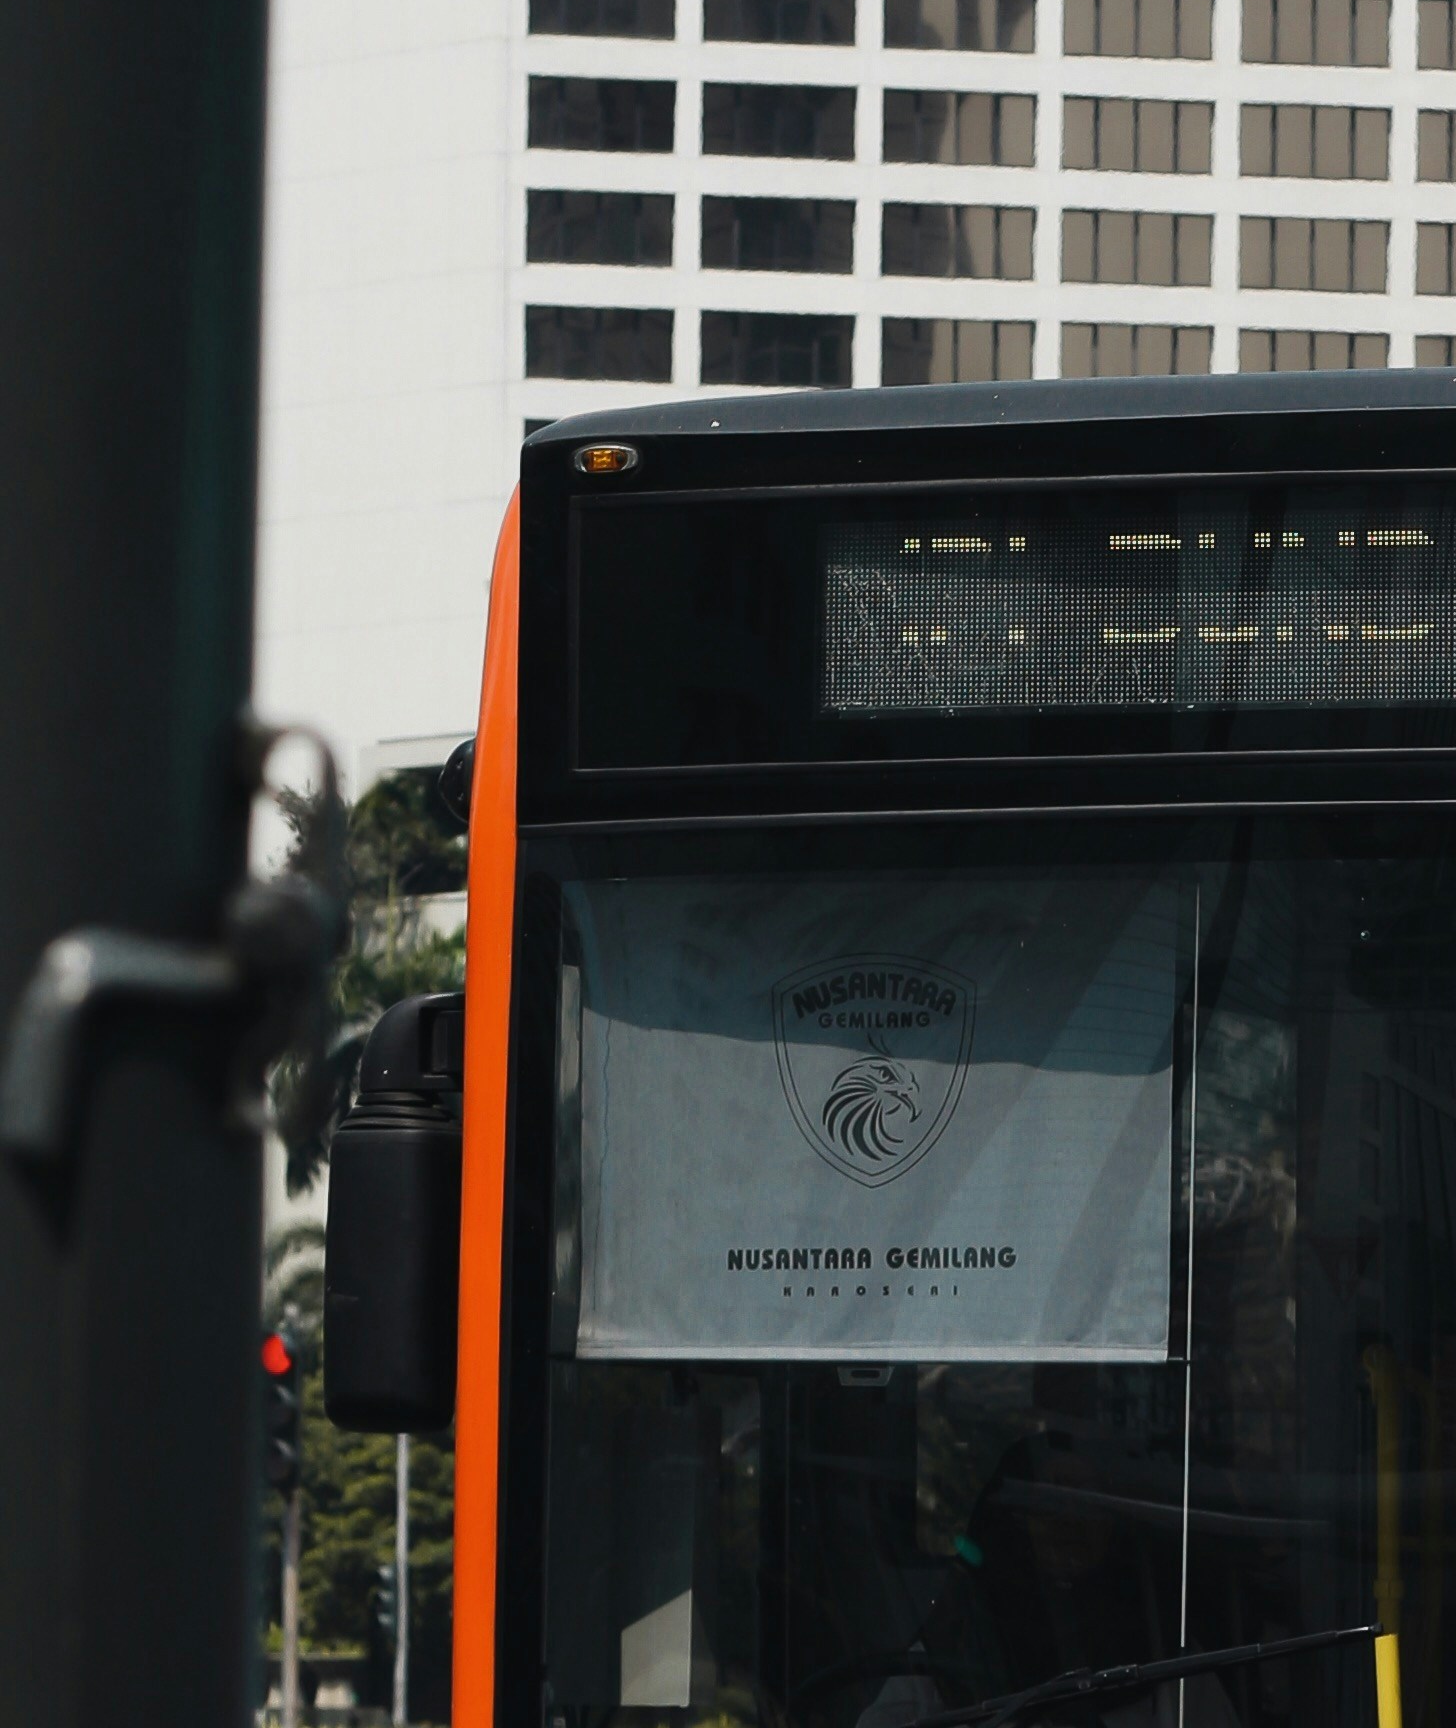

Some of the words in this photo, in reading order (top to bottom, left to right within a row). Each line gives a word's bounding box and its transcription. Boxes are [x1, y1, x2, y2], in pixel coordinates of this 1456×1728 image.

[792, 971, 957, 1019] NUSANTARA
[818, 1011, 931, 1028] GEMILANG
[727, 1247, 872, 1271] NUSANTARA
[886, 1246, 1017, 1269] GEMILANG
